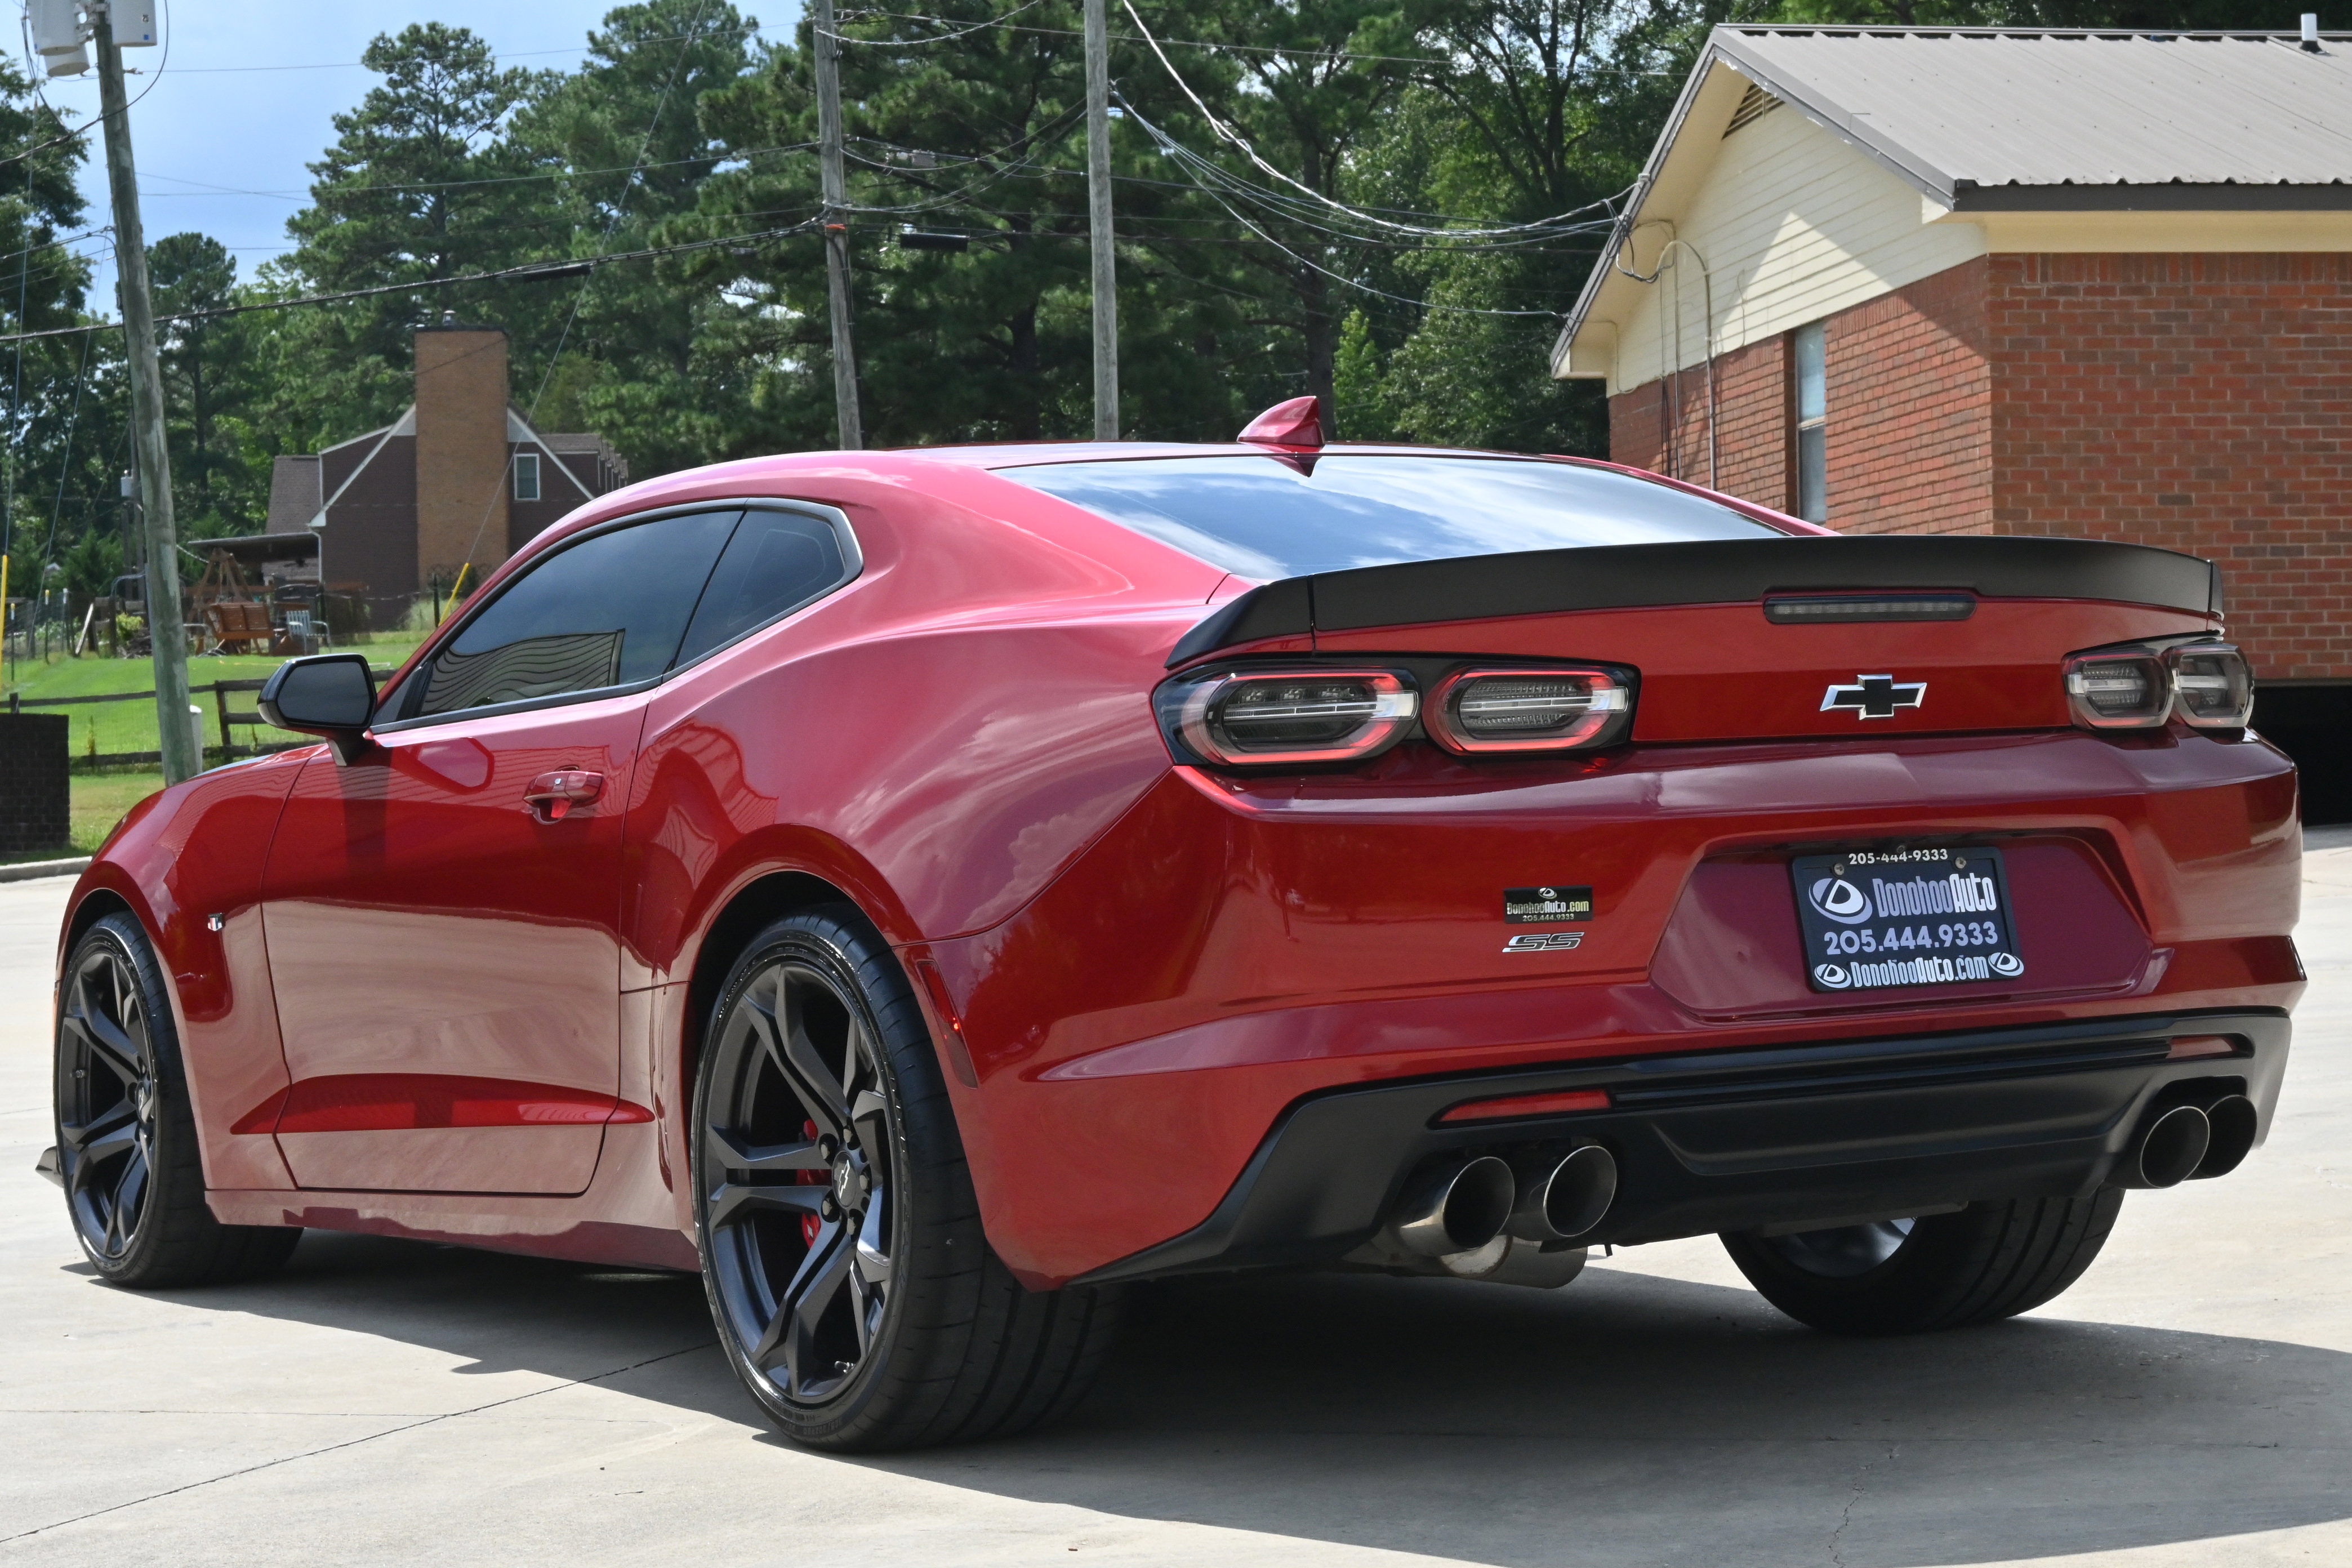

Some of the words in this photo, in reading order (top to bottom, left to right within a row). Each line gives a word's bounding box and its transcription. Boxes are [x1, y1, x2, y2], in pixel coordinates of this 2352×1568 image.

[1848, 849, 1949, 865] 205-444-9333
[1522, 914, 1575, 922] 205.444.9333
[1502, 932, 1585, 952] SS
[1824, 921, 1998, 955] 205.444.9333
[1851, 956, 1990, 988] DonohooAuto.com
